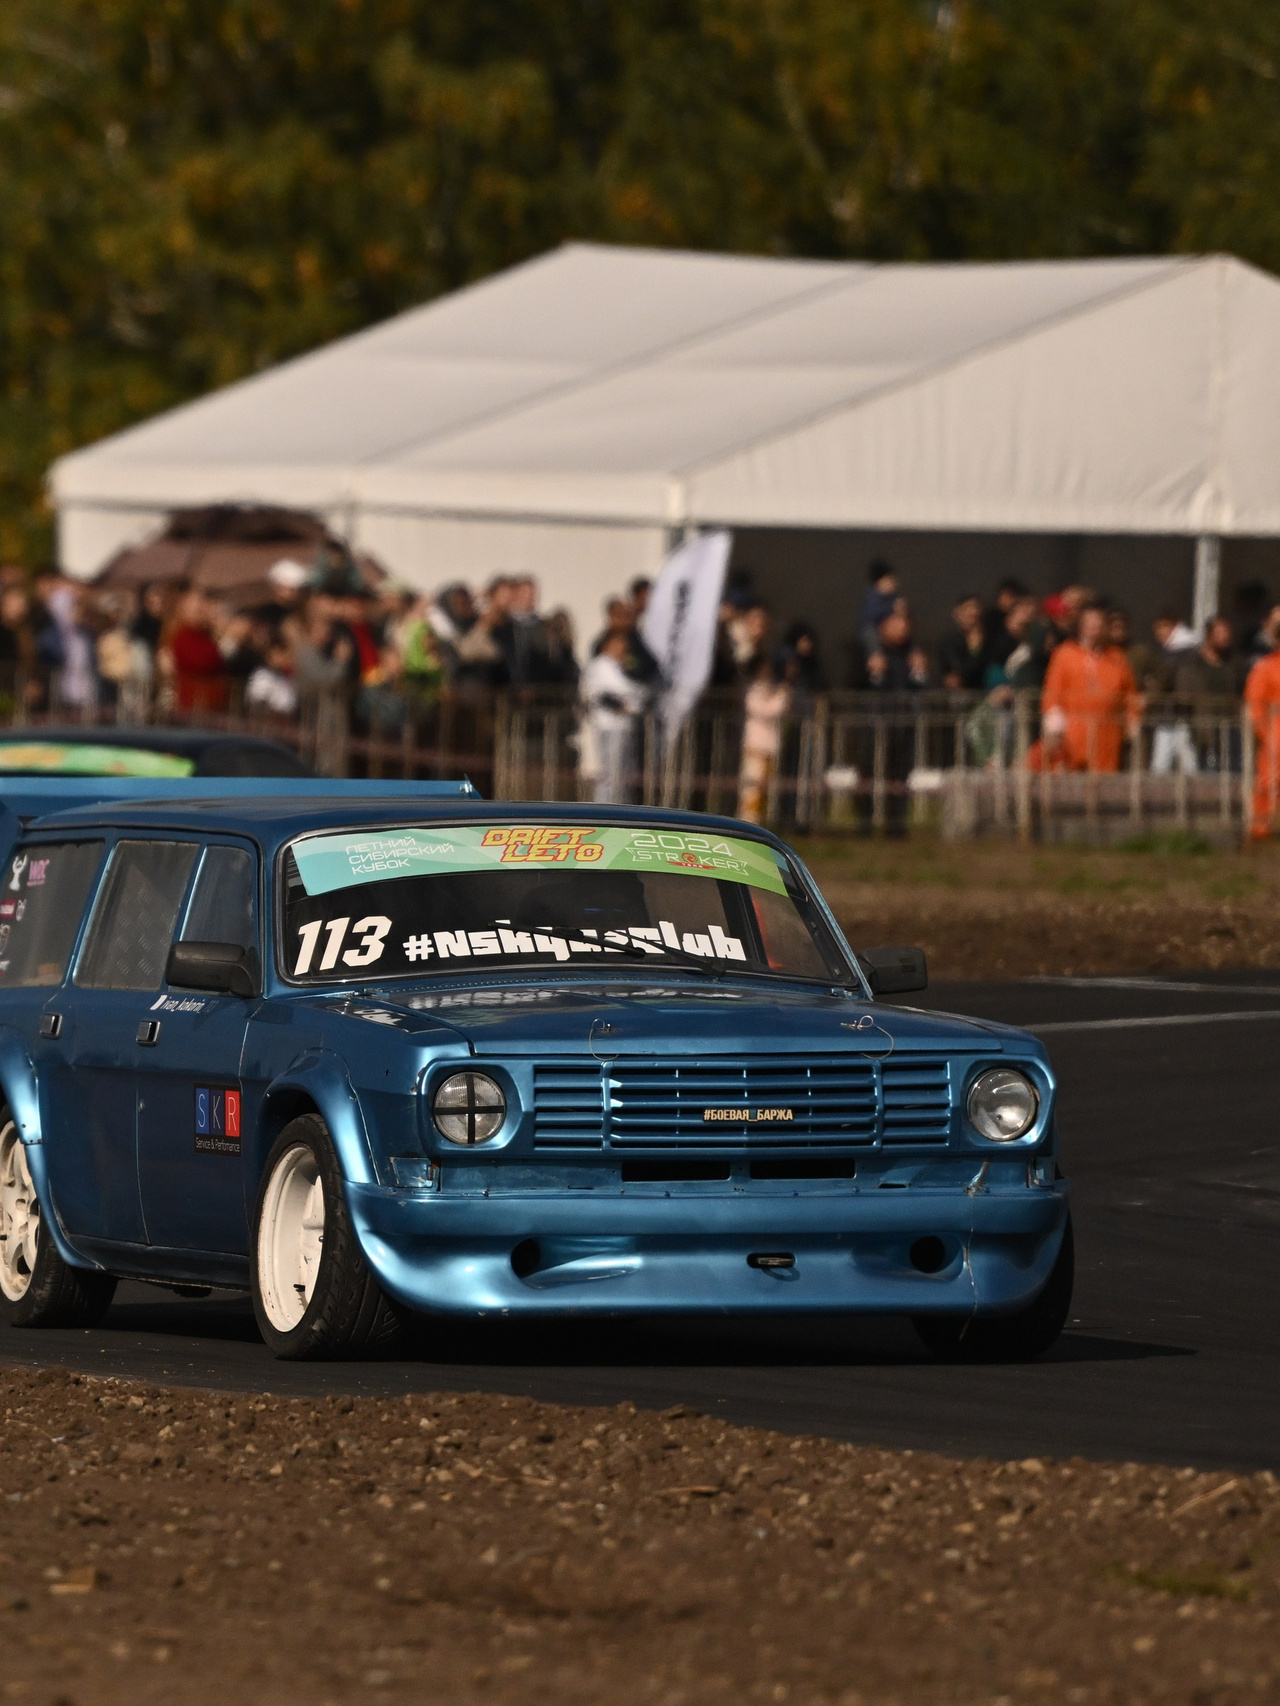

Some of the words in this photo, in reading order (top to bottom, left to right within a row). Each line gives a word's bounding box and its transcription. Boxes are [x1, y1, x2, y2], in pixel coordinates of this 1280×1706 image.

[481, 828, 596, 847] DRIFT
[631, 833, 732, 857] 2024
[348, 843, 455, 865] СИБИРСКИЙ
[500, 844, 604, 862] LETO
[352, 858, 410, 875] КУБОК
[293, 915, 393, 976] 113
[197, 1093, 237, 1131] SKR
[703, 1109, 794, 1122] #БОЕВАЯ_БАРЖА
[195, 1137, 210, 1150] Service
